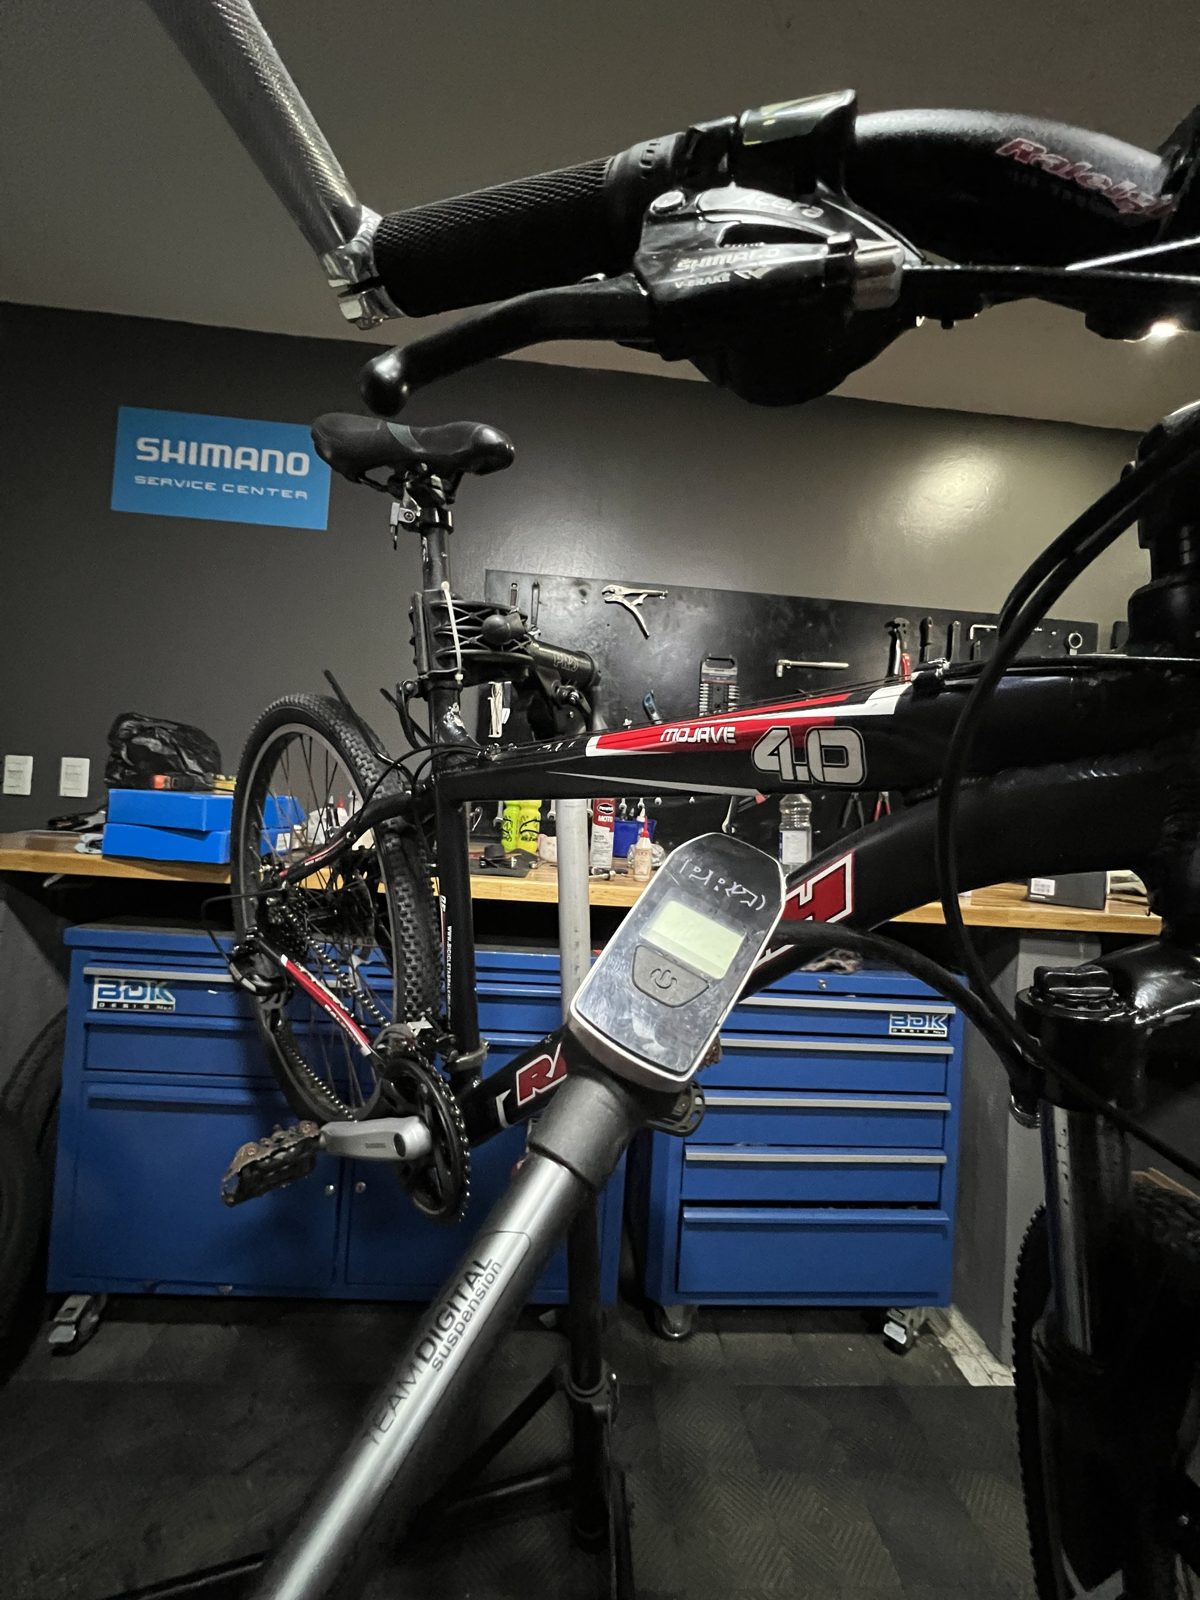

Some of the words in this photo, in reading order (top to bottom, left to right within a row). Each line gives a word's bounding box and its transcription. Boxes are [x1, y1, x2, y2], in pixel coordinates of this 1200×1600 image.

[135, 437, 310, 477] SHIMANO
[133, 475, 217, 492] SERVICE
[221, 483, 309, 501] CENTER
[660, 726, 737, 745] MOJAVE
[93, 978, 175, 1004] BDK
[890, 1013, 949, 1029] BDK
[415, 1256, 494, 1364] DIGITAL
[431, 1260, 503, 1373] suspension
